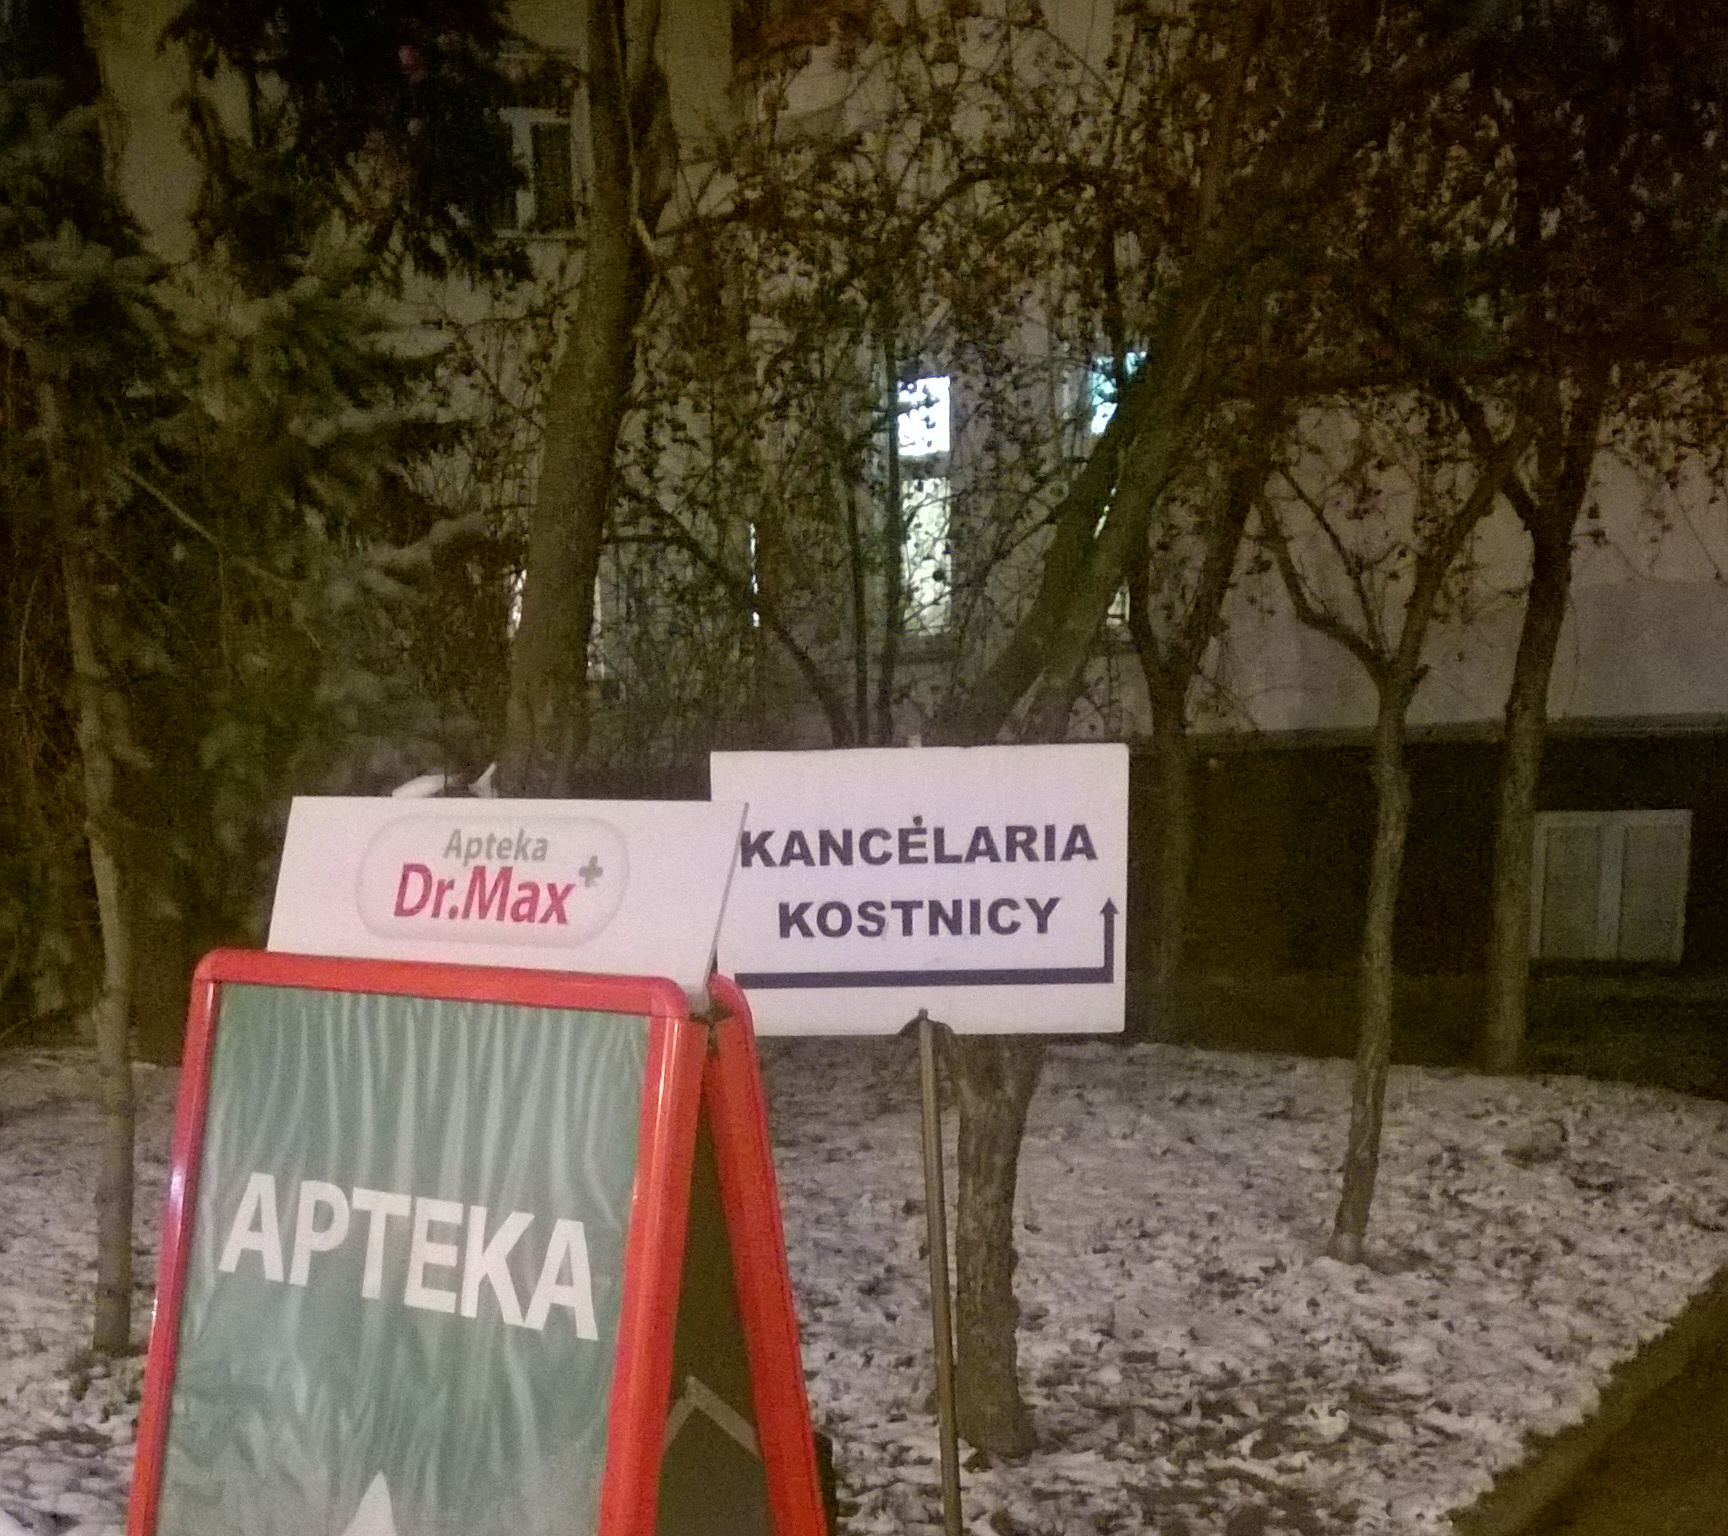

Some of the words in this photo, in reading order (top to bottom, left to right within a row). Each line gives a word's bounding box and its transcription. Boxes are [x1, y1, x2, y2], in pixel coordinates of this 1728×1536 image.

[443, 828, 549, 867] Apteka
[740, 823, 1098, 867] KANCELARIA
[779, 897, 1061, 938] KOSTNICY
[218, 1171, 598, 1341] APTEKA
